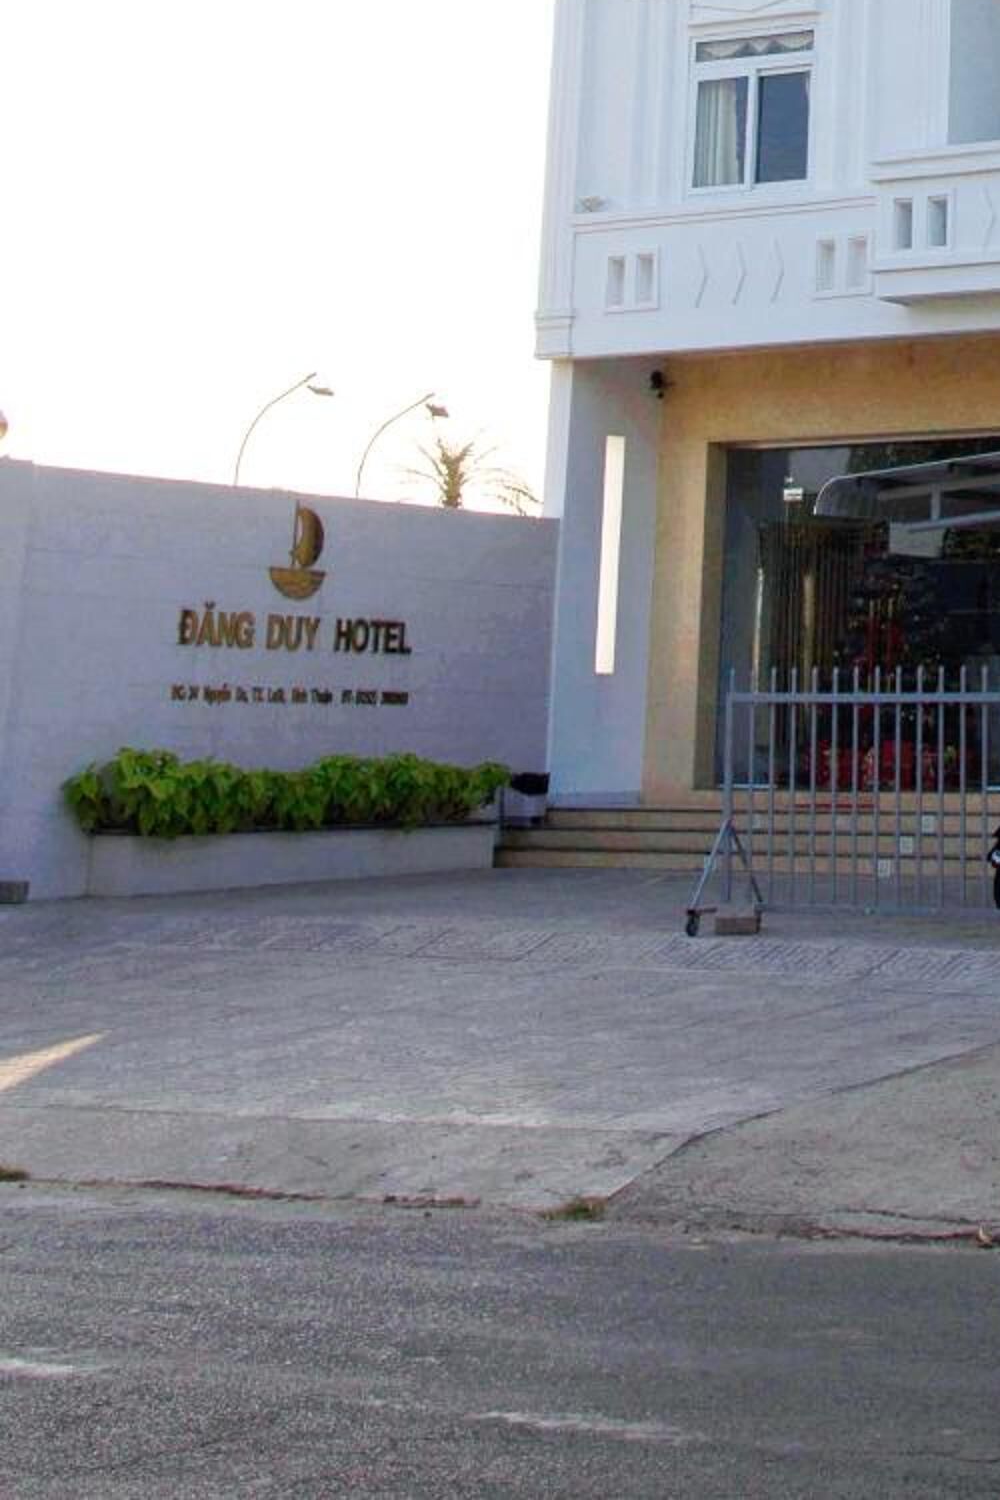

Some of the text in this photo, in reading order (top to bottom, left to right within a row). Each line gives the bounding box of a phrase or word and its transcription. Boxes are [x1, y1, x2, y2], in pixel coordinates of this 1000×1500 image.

[180, 602, 411, 654] ĐĂNG DUY HOTEL
